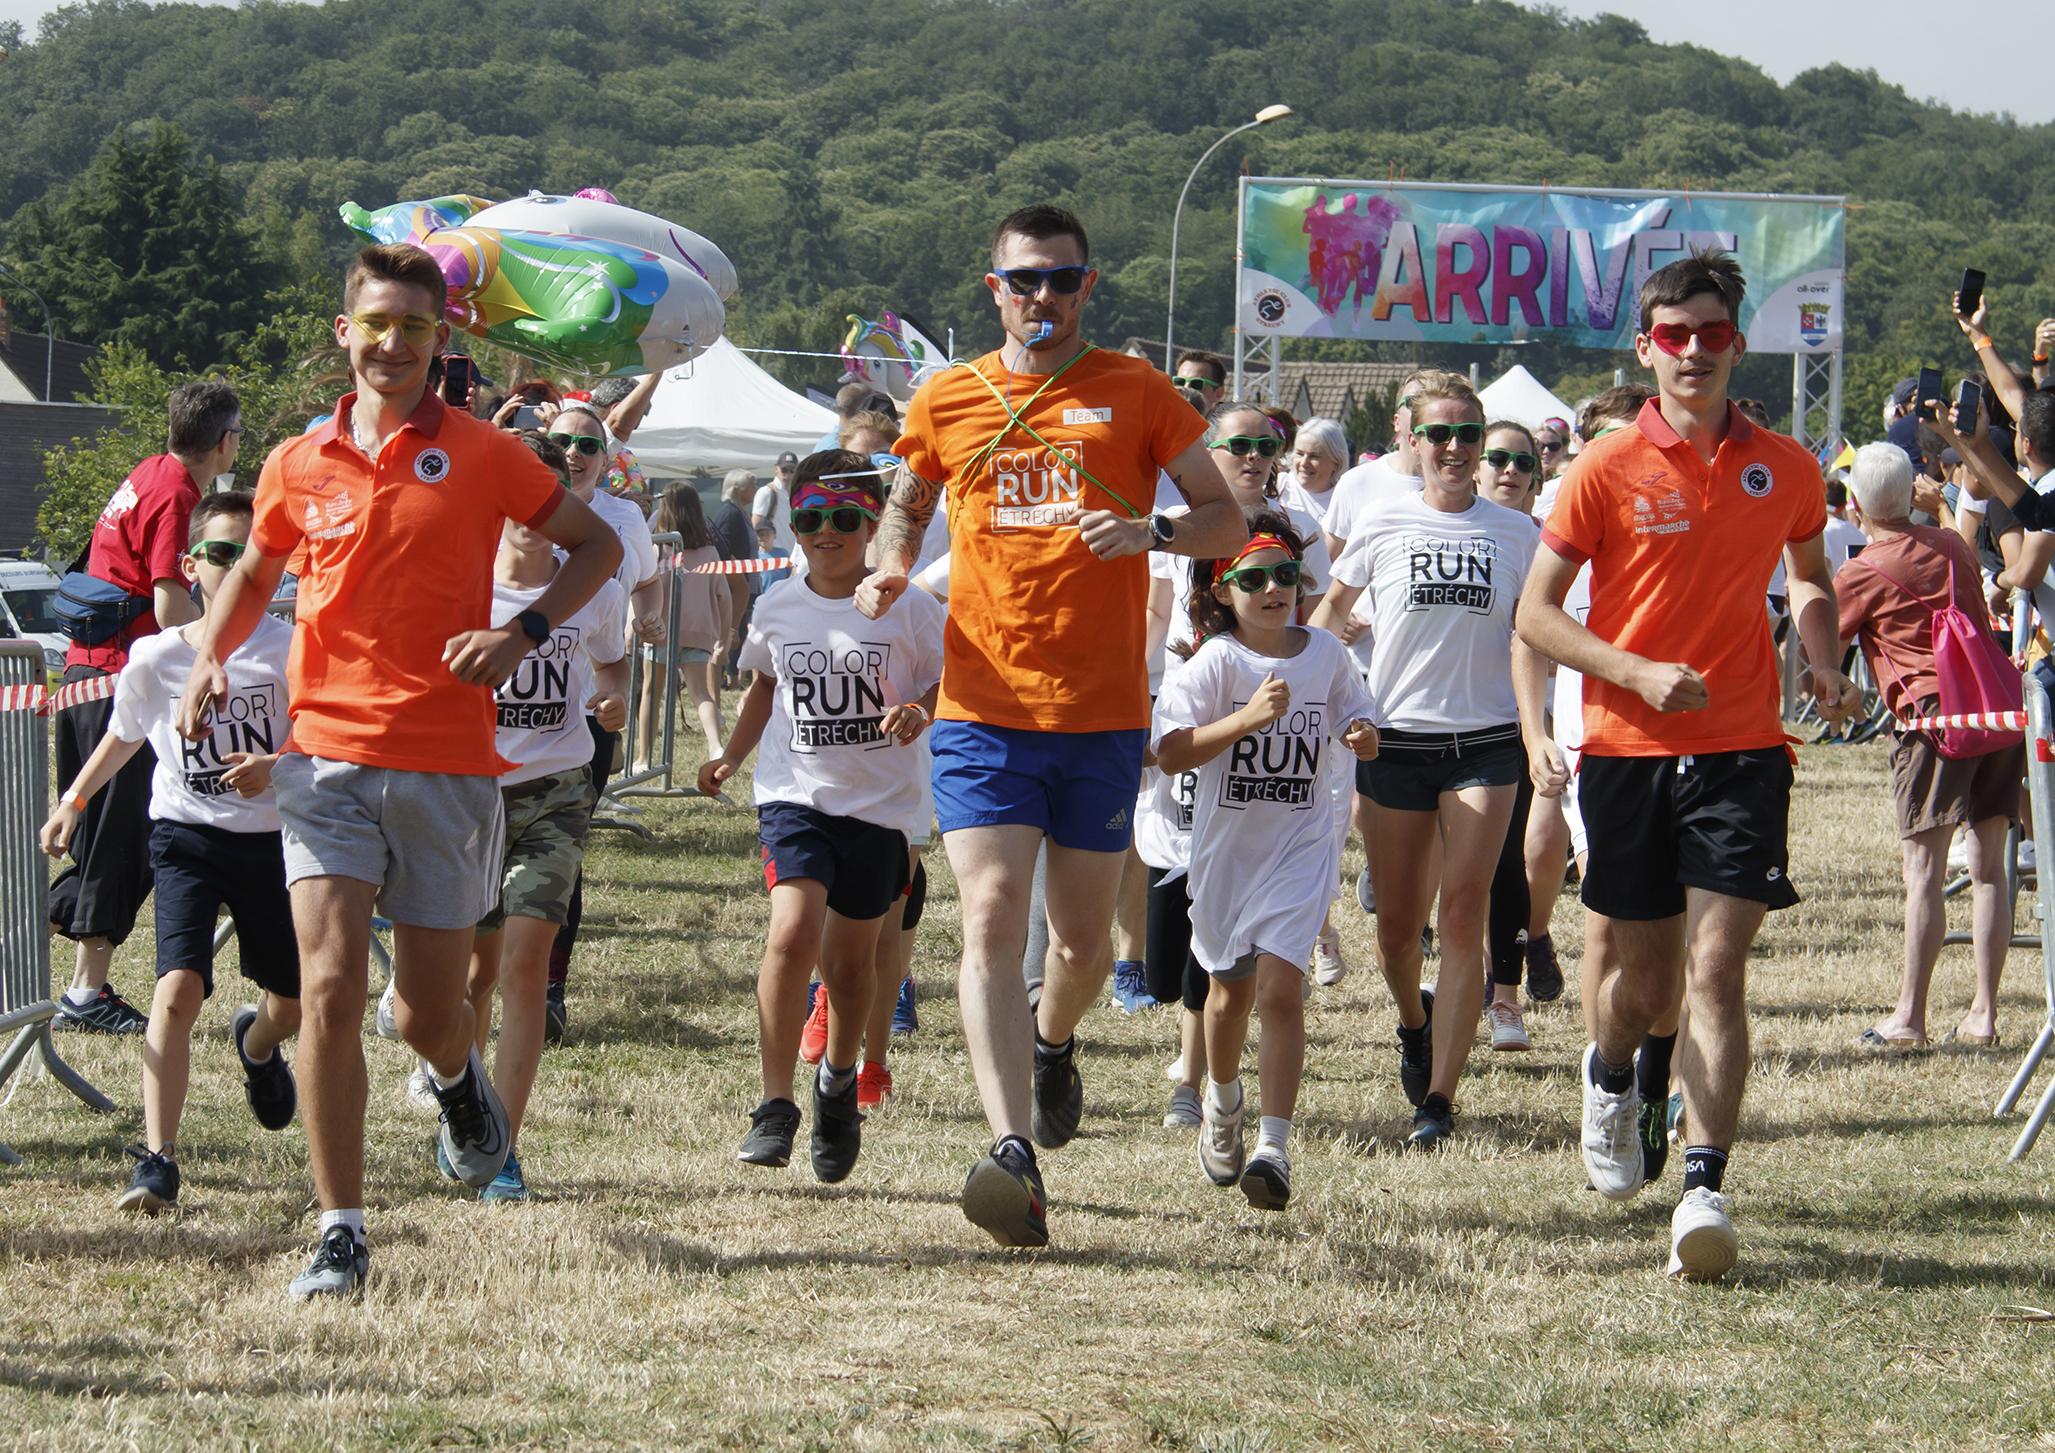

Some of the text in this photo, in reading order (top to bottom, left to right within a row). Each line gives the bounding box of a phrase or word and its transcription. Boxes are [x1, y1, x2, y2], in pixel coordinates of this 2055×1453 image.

[1371, 207, 1738, 331] ARRIVÉ
[1071, 410, 1104, 422] Team
[996, 447, 1077, 473] COLOR
[997, 468, 1079, 506] RUN
[1410, 552, 1492, 585] RUN
[1411, 585, 1490, 607] ÉTRÉCHY
[788, 649, 882, 676] COLOR
[204, 693, 269, 726] LOR
[792, 675, 885, 717] RUN
[497, 704, 565, 729] RÉCHY
[1257, 710, 1322, 736] LOR
[797, 720, 883, 746] ÉTRÉCHY
[1230, 735, 1320, 775] RUN
